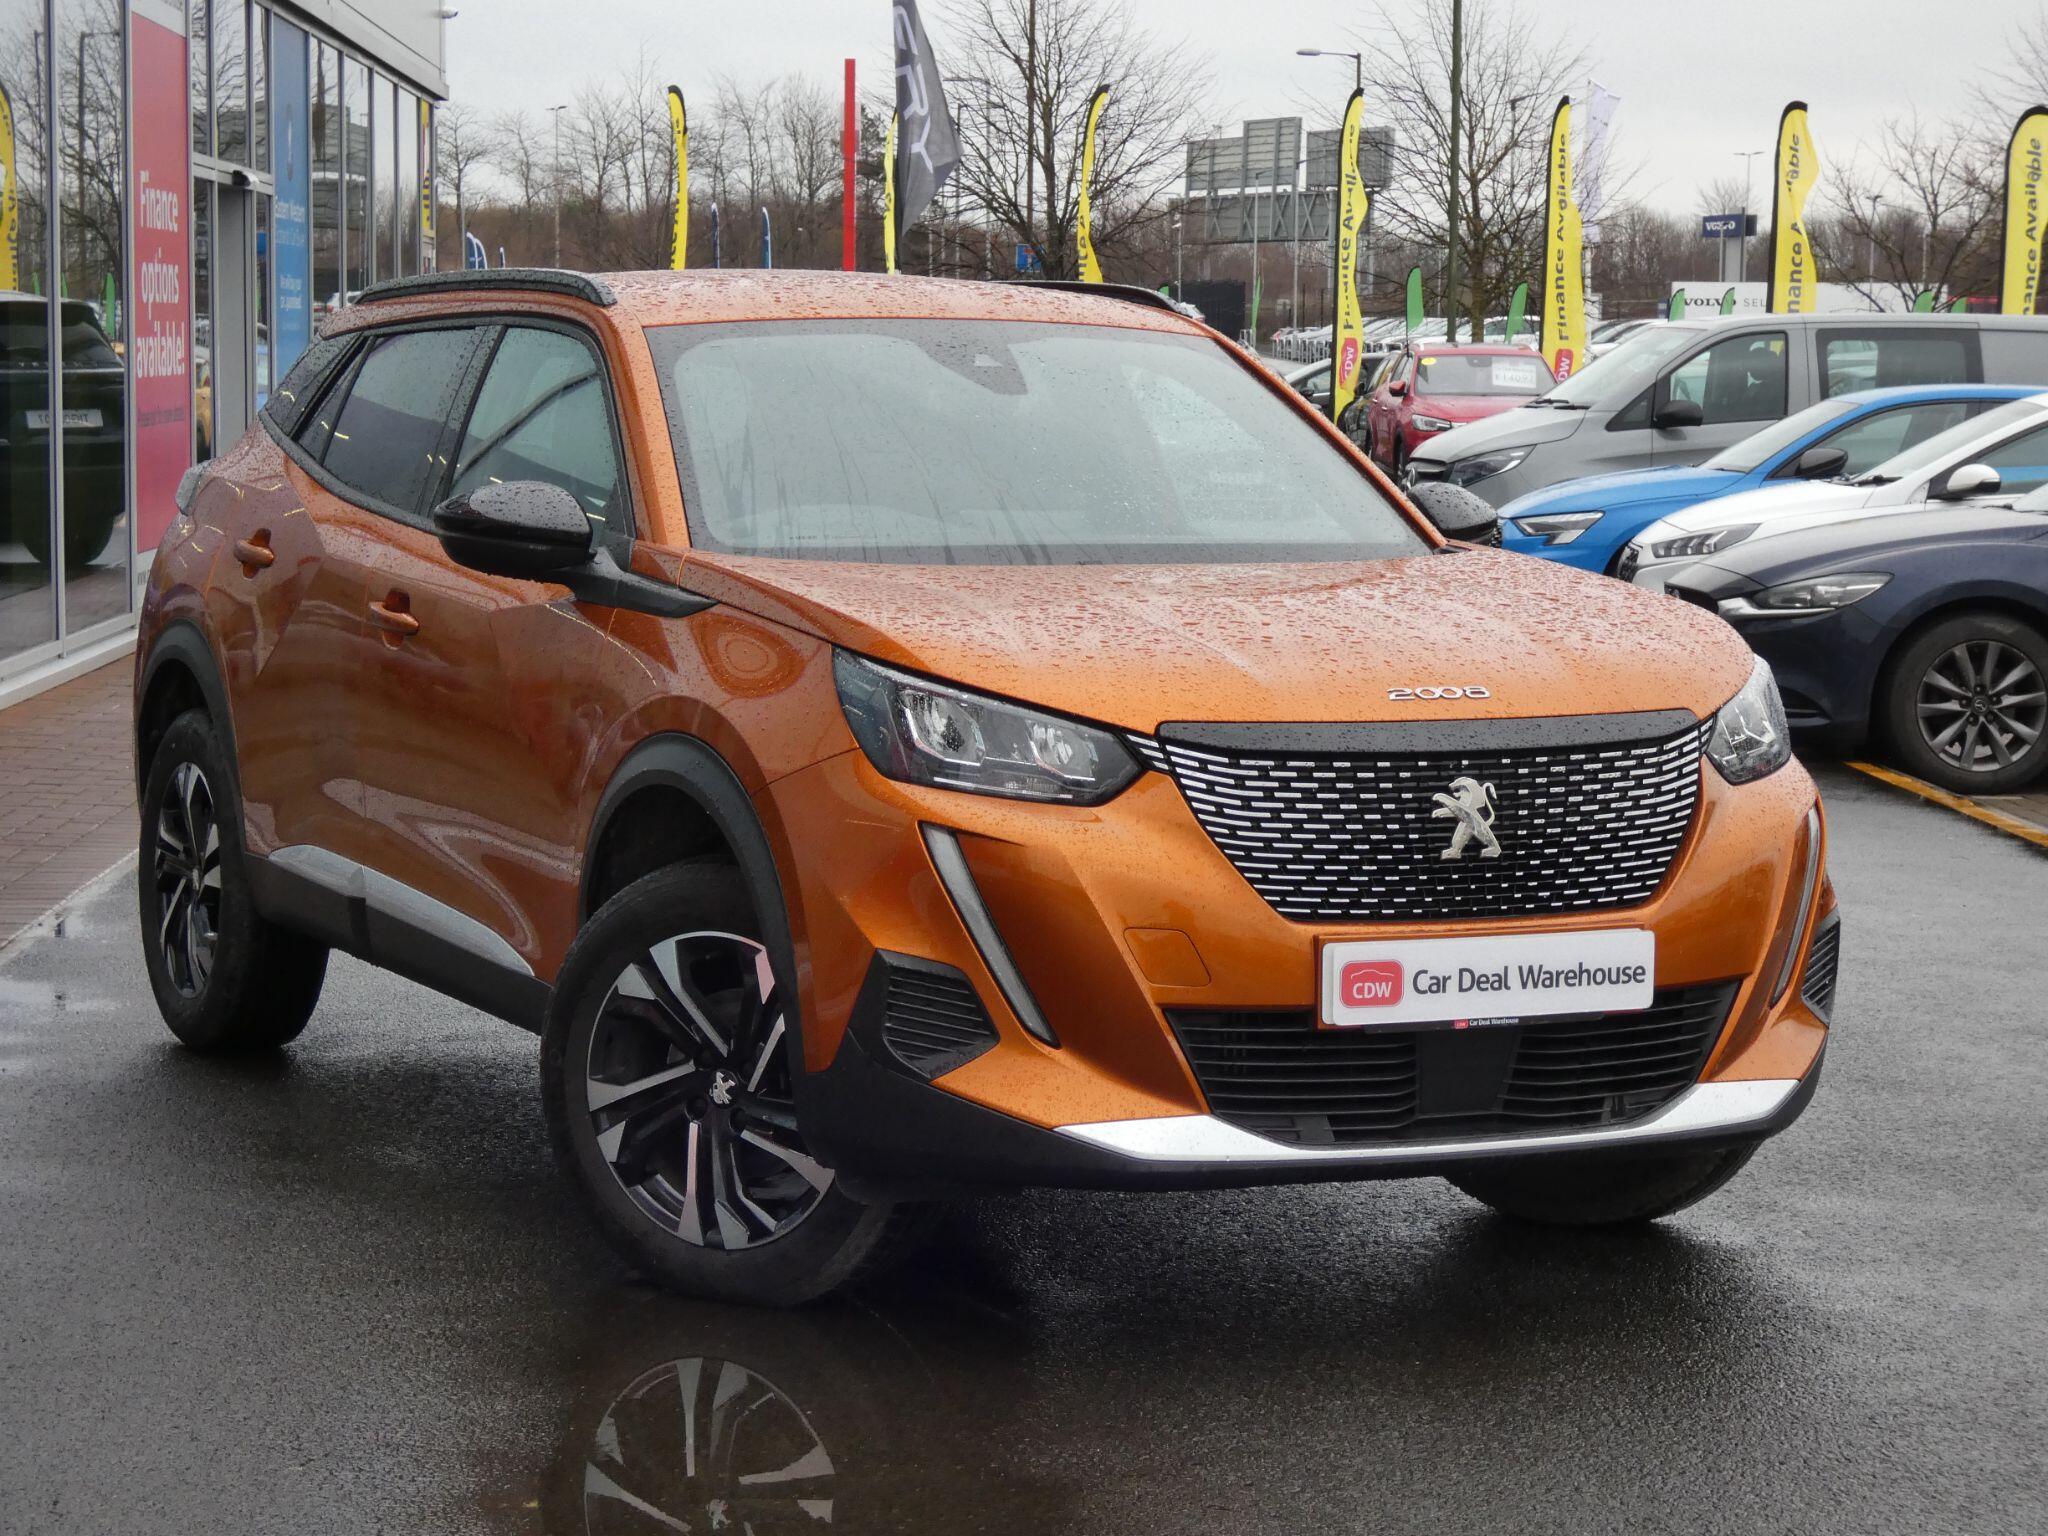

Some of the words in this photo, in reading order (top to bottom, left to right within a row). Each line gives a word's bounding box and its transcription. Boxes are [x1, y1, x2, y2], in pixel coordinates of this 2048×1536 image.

[140, 170, 178, 232] Finance
[1555, 133, 1568, 241] Available
[2025, 138, 2042, 242] Available
[141, 247, 179, 320] options
[1555, 247, 1569, 341] Finance
[1684, 298, 1737, 307] VOLV
[1786, 242, 1803, 313] nance
[2023, 249, 2037, 314] ance
[137, 320, 185, 378] available!
[1557, 356, 1569, 382] DW
[1387, 686, 1491, 700] 2008
[1352, 981, 1391, 999] CDW
[1412, 969, 1451, 995] Car
[1458, 966, 1511, 993] Deal
[1518, 961, 1647, 990] Warehouse
[1491, 1017, 1519, 1025] Warehouse
